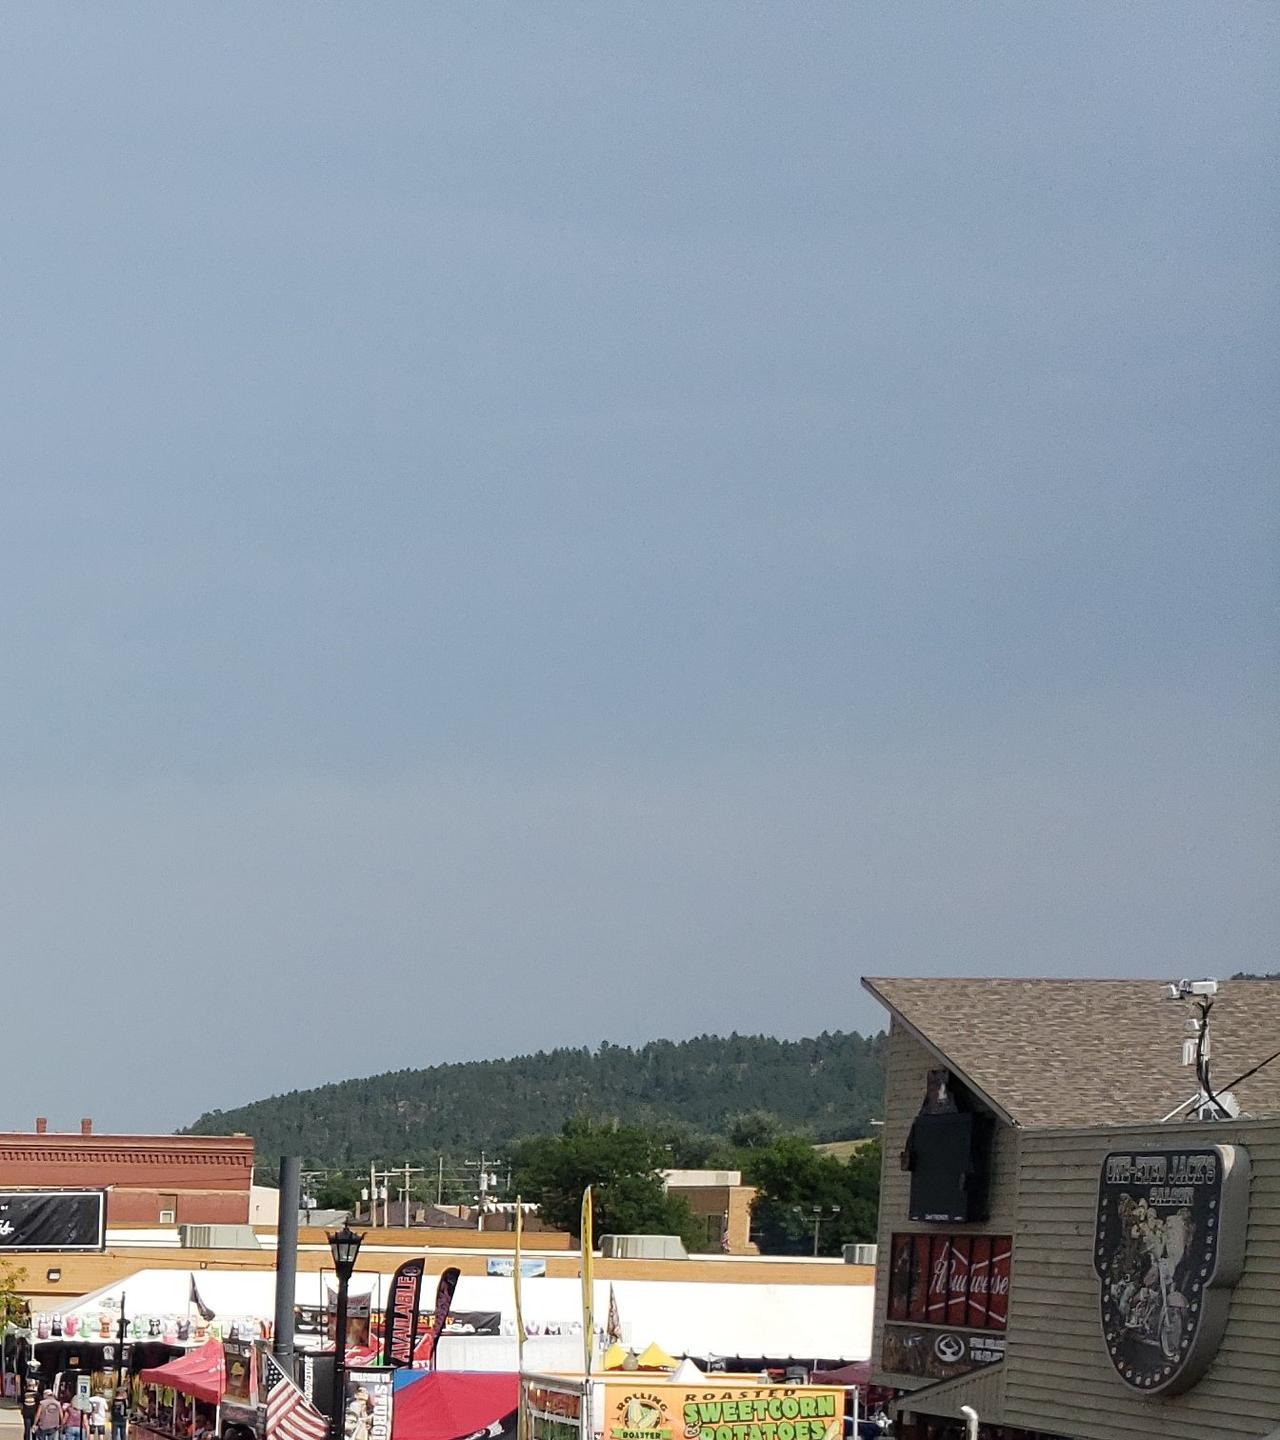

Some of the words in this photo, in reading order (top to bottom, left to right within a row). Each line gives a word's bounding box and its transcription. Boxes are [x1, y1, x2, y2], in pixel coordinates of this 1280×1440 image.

[391, 1275, 417, 1362] AVAILABLE
[615, 1391, 669, 1412] ROLLING
[684, 1388, 797, 1402] ROASTED
[682, 1394, 836, 1424] SWEETCORN
[684, 1420, 703, 1438] &
